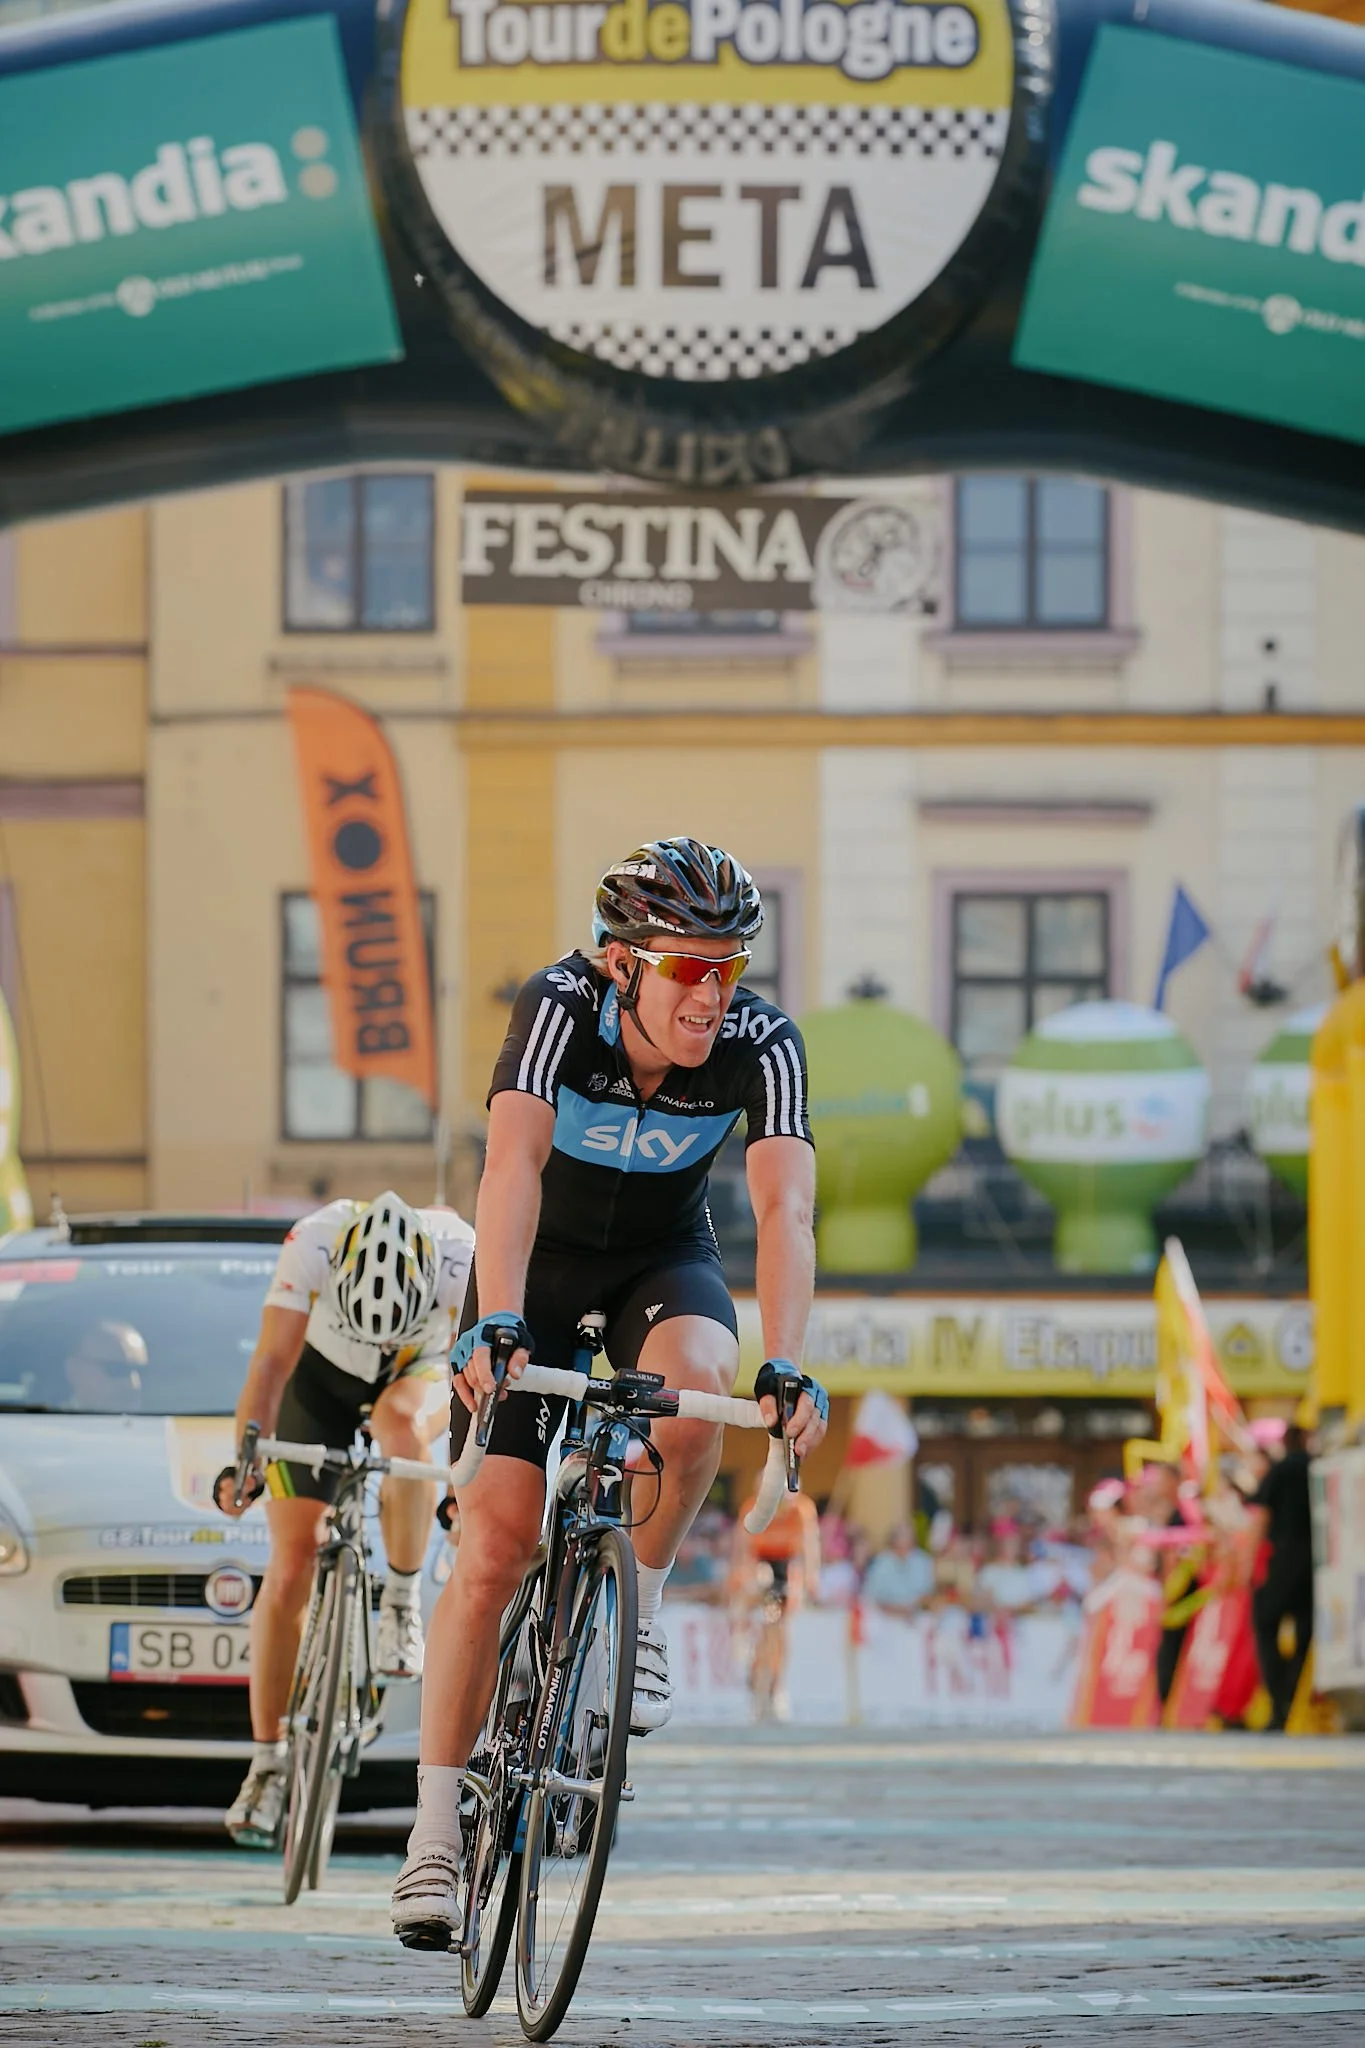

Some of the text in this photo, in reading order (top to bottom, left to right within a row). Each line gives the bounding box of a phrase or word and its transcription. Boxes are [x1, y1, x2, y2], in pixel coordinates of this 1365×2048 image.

[542, 184, 877, 288] META
[461, 502, 814, 582] FESTINA
[546, 970, 598, 1012] sky
[720, 1006, 788, 1045] sky
[581, 1117, 701, 1167] sky
[139, 1630, 194, 1669] SB
[538, 1667, 562, 1750] PINARELLO
